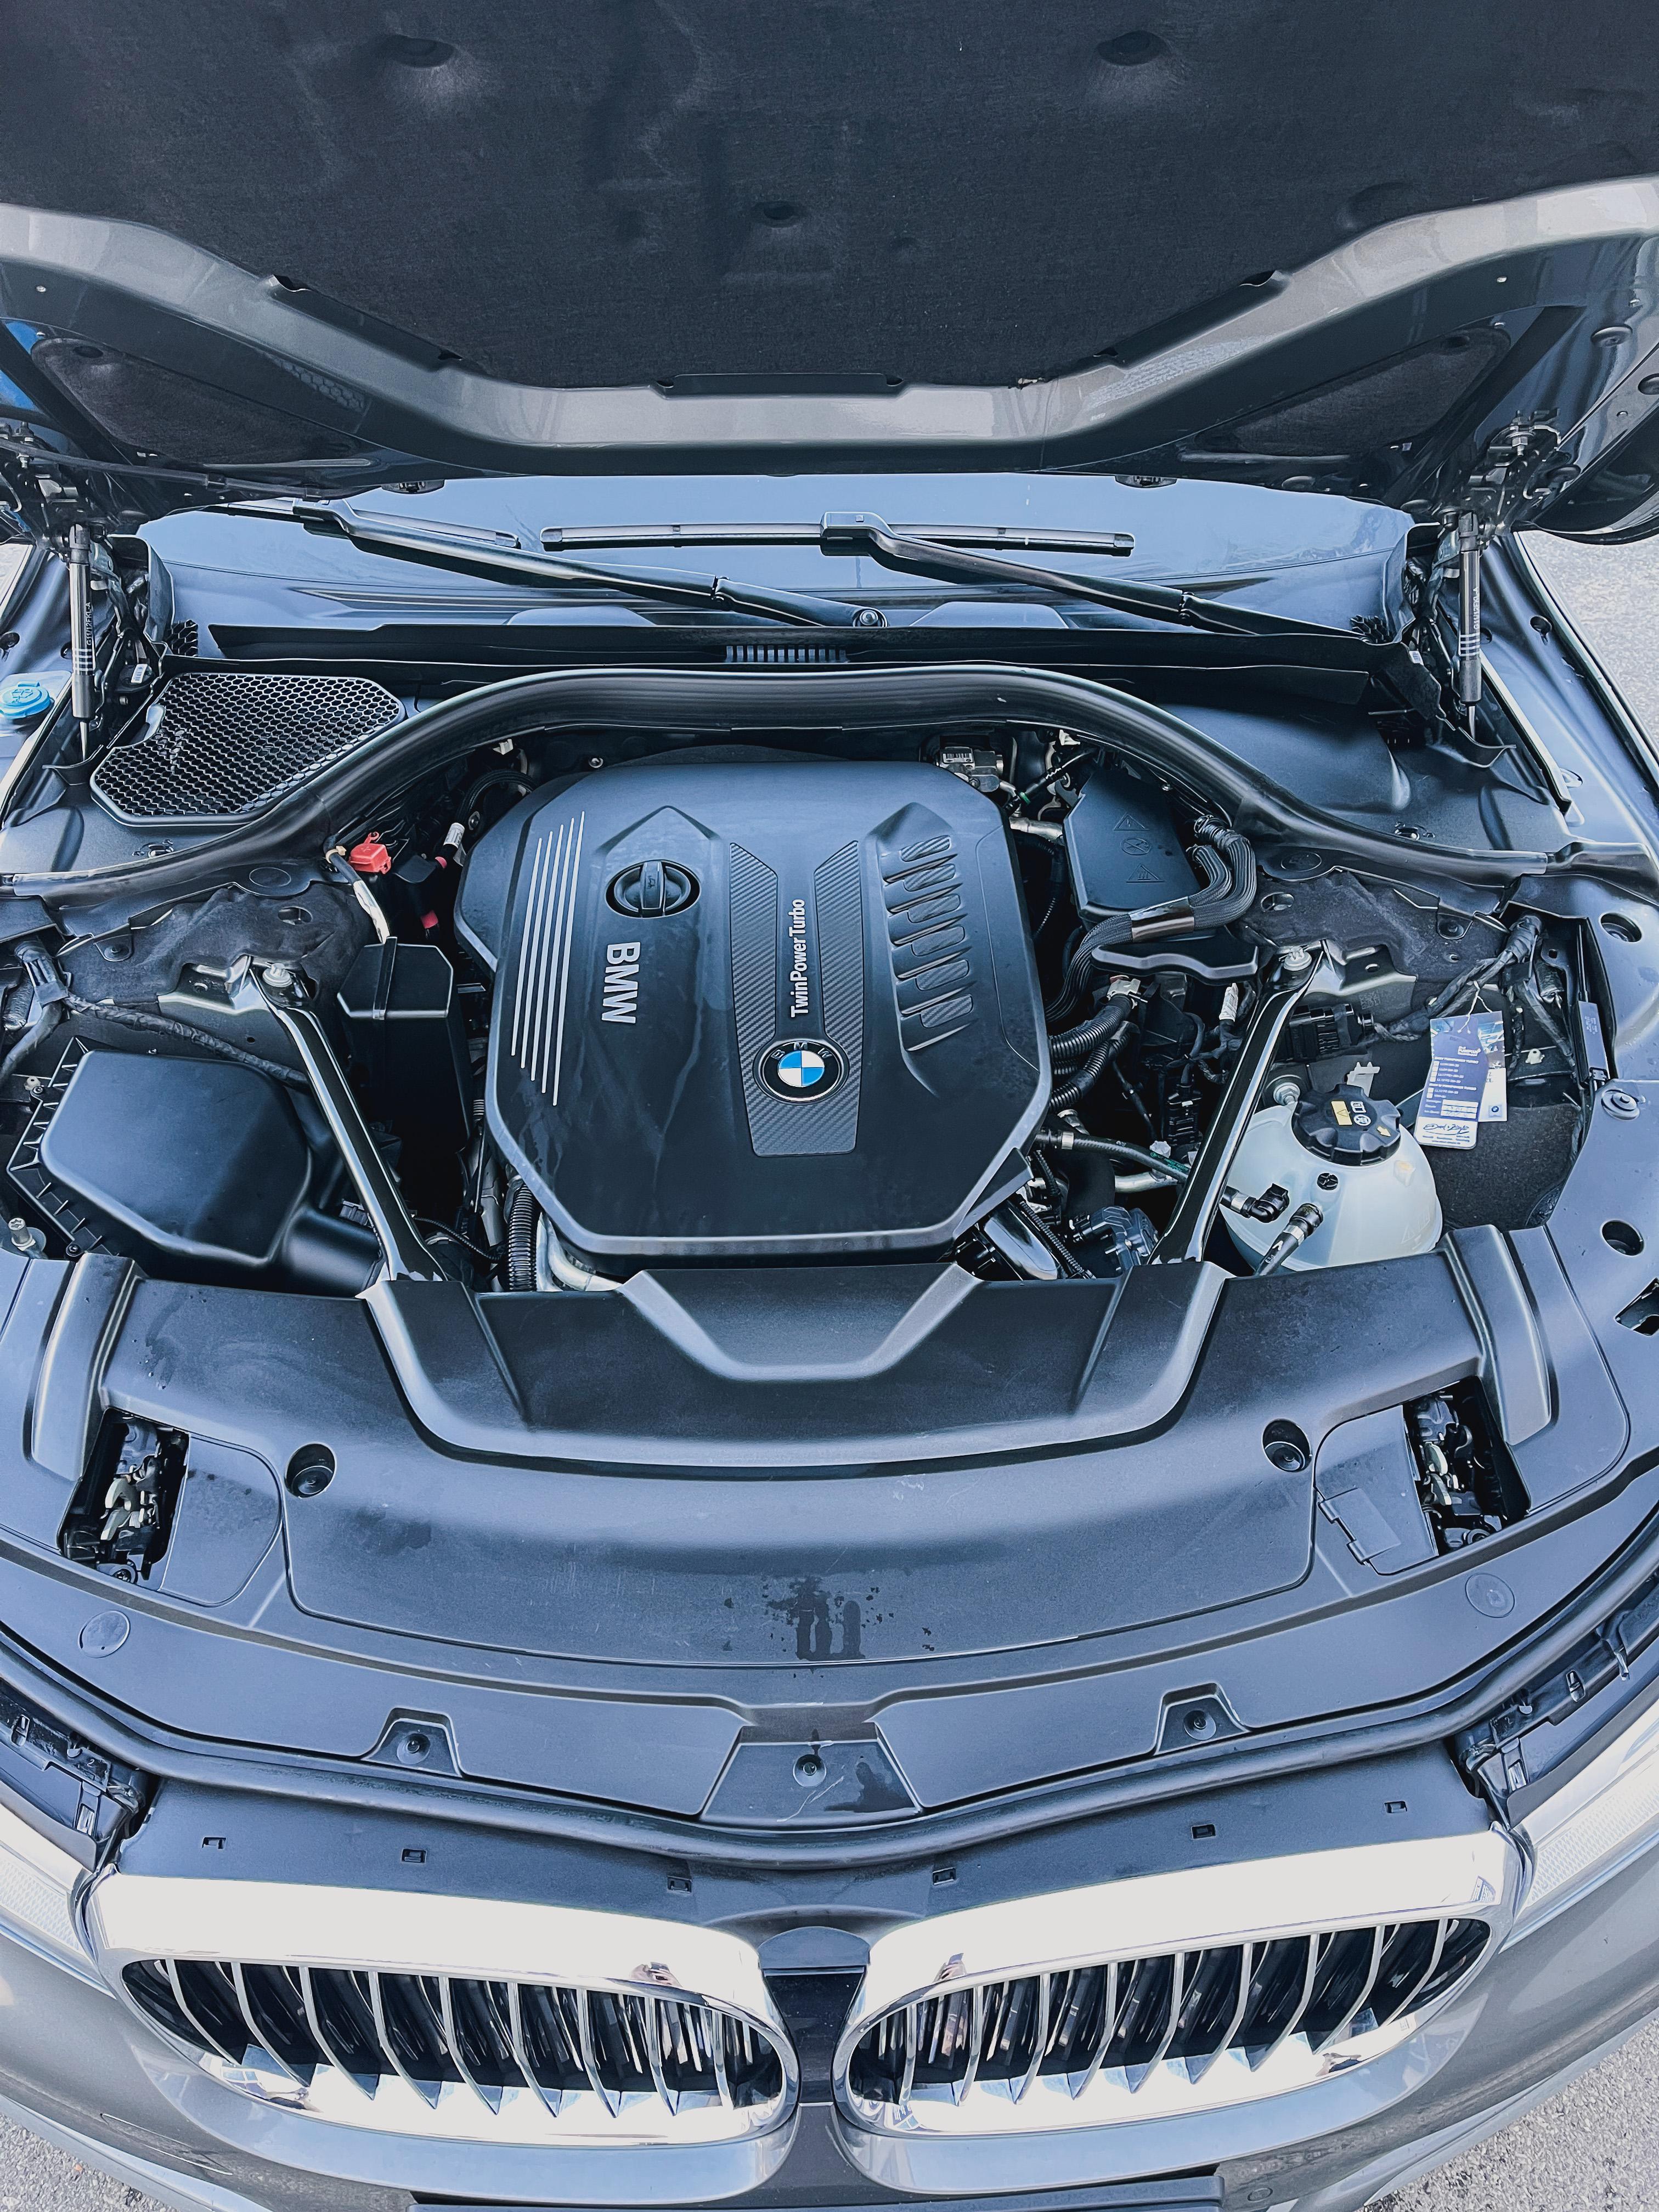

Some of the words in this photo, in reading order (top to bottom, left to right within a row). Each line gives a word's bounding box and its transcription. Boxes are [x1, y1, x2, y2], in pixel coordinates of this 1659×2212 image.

[601, 941, 641, 1024] BMW
[770, 1042, 832, 1060] BMW
[87, 1759, 95, 1768] 2
